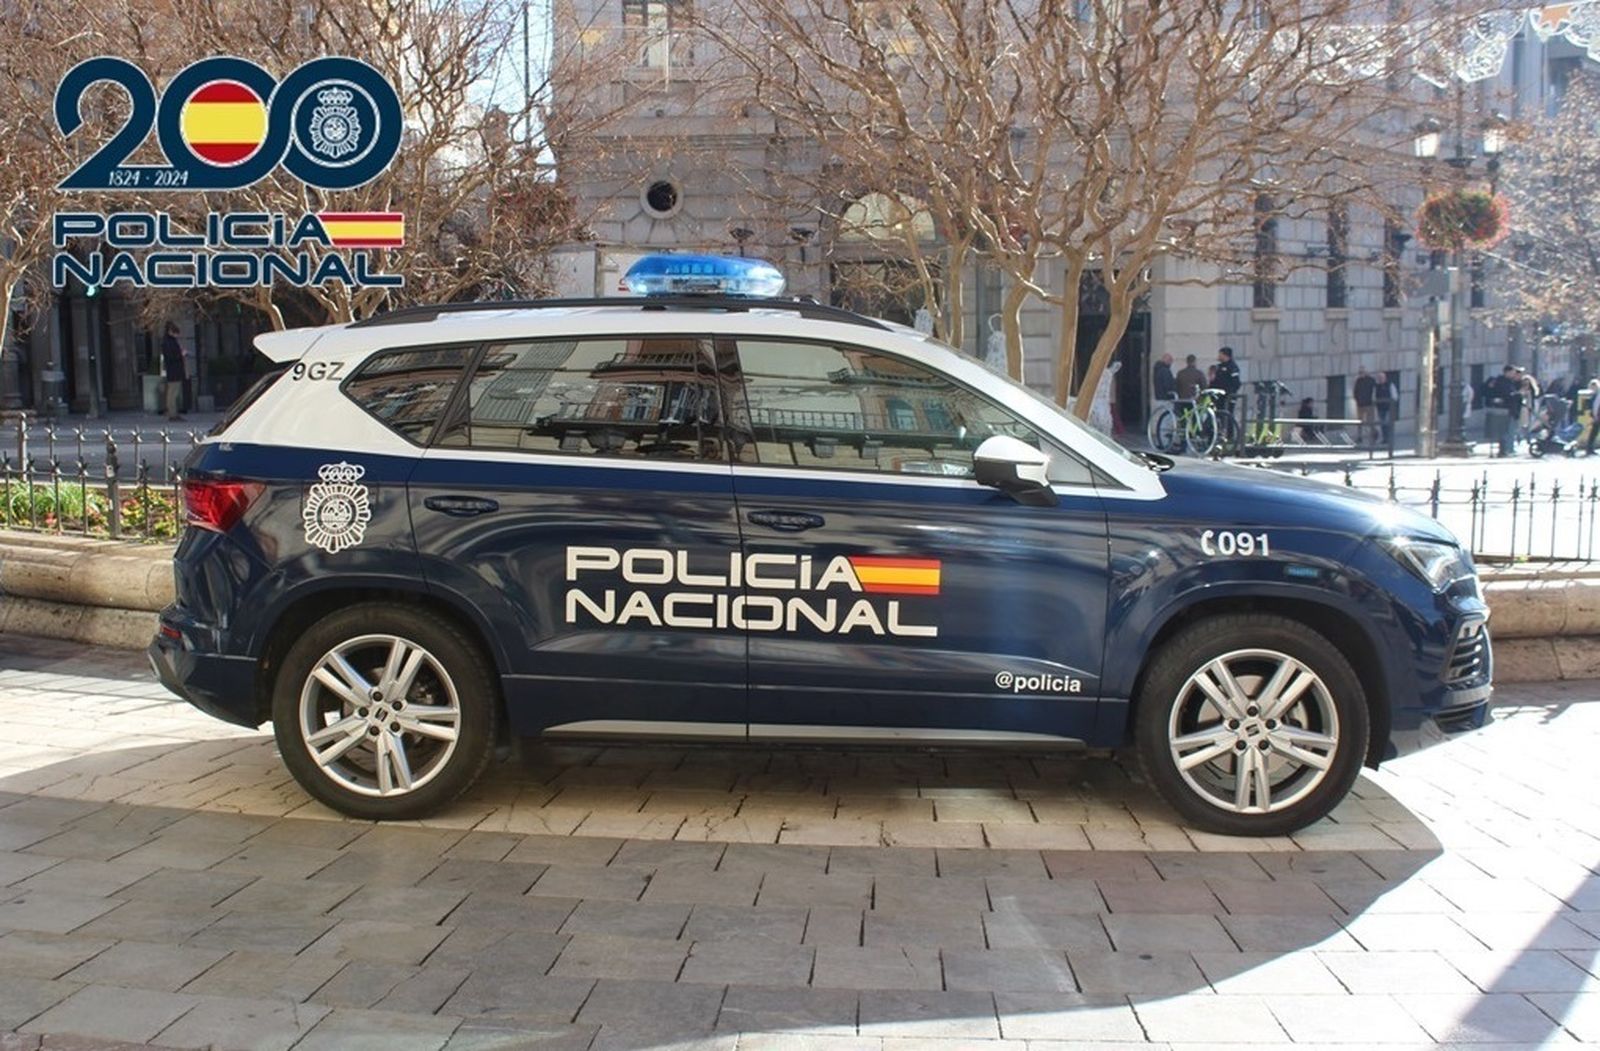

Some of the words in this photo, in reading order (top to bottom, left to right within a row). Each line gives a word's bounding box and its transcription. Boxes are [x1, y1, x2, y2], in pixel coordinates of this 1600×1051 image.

[292, 361, 345, 381] 9GZ
[1218, 531, 1269, 556] 091
[565, 589, 938, 637] NACIONAL
[995, 671, 1082, 693] @policia
